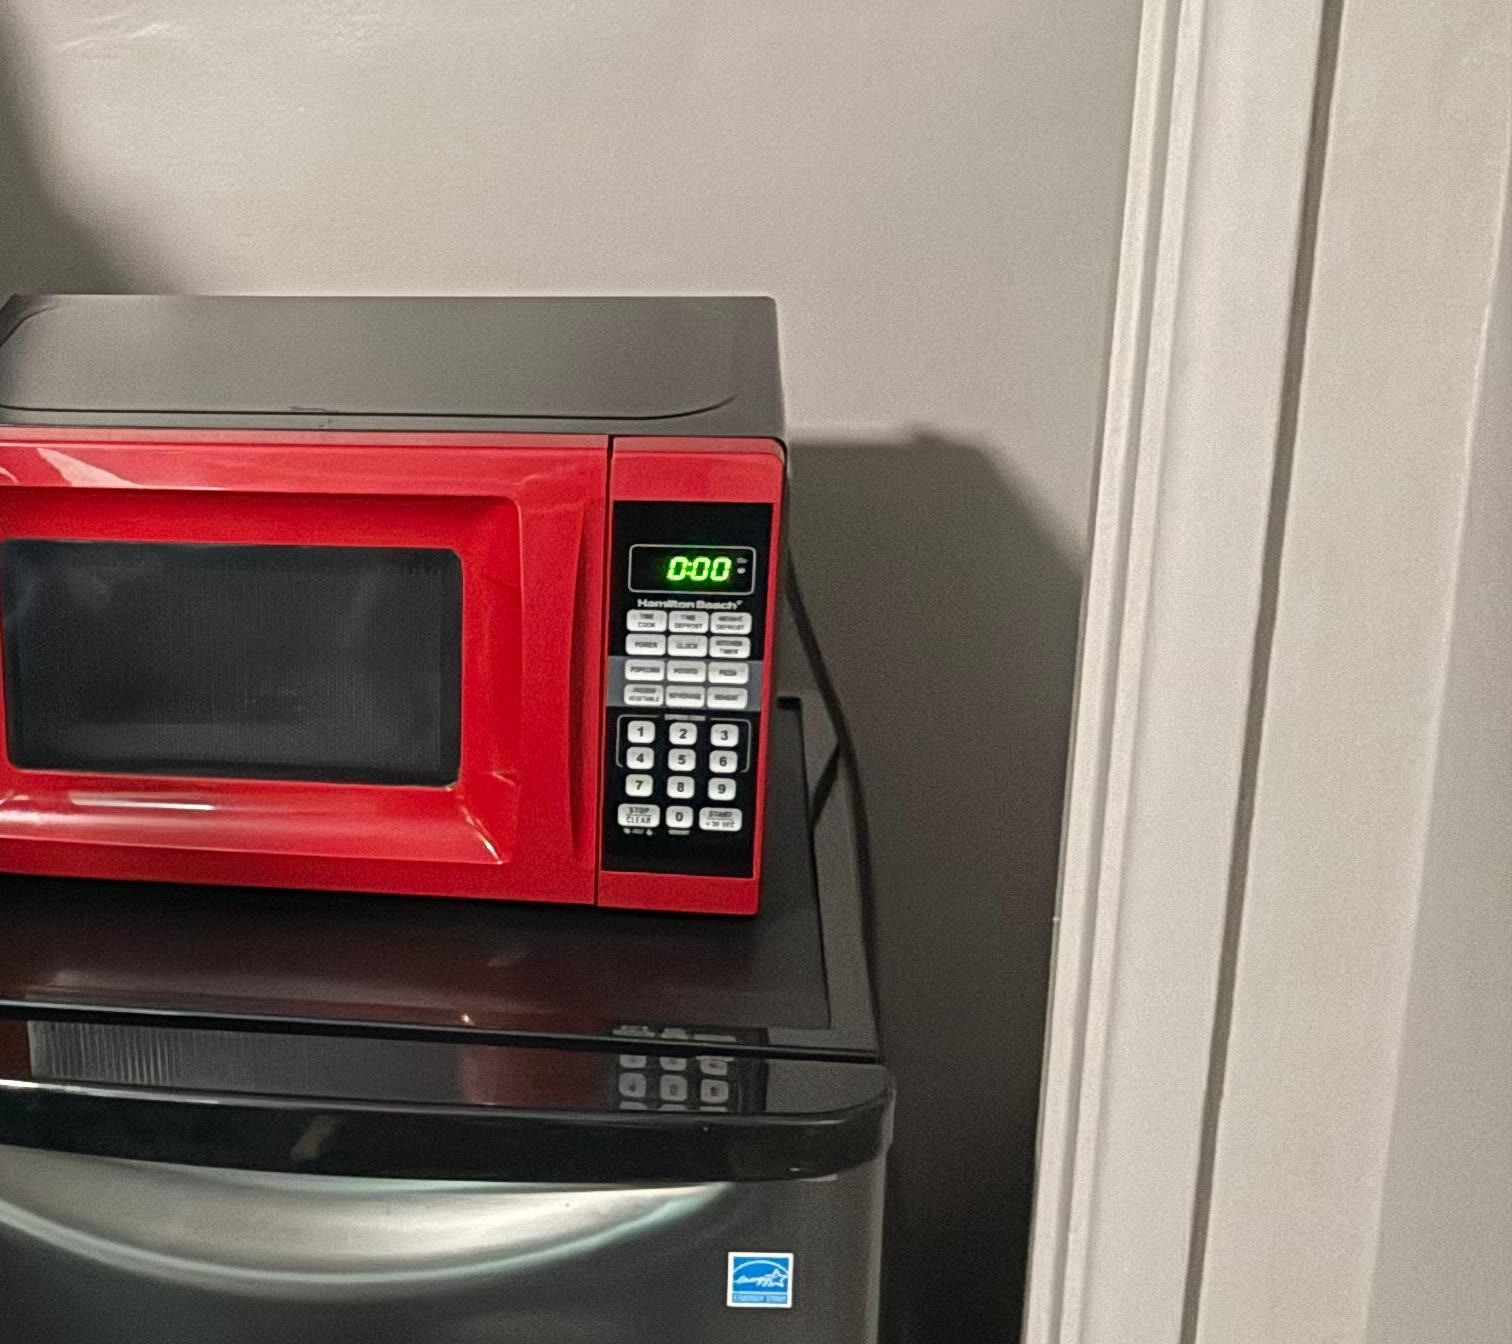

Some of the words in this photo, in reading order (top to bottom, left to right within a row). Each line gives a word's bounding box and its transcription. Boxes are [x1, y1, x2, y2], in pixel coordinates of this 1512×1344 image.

[666, 556, 732, 581] 0:00
[637, 599, 695, 609] Hamilton
[637, 726, 644, 737] 1
[679, 728, 688, 739] 2
[720, 730, 728, 741] 3
[636, 753, 644, 763] 4
[678, 754, 686, 765] 5
[719, 756, 727, 767] 6
[635, 780, 644, 790] 7
[676, 782, 684, 792] 8
[717, 784, 726, 794] 9
[675, 811, 683, 822] 0
